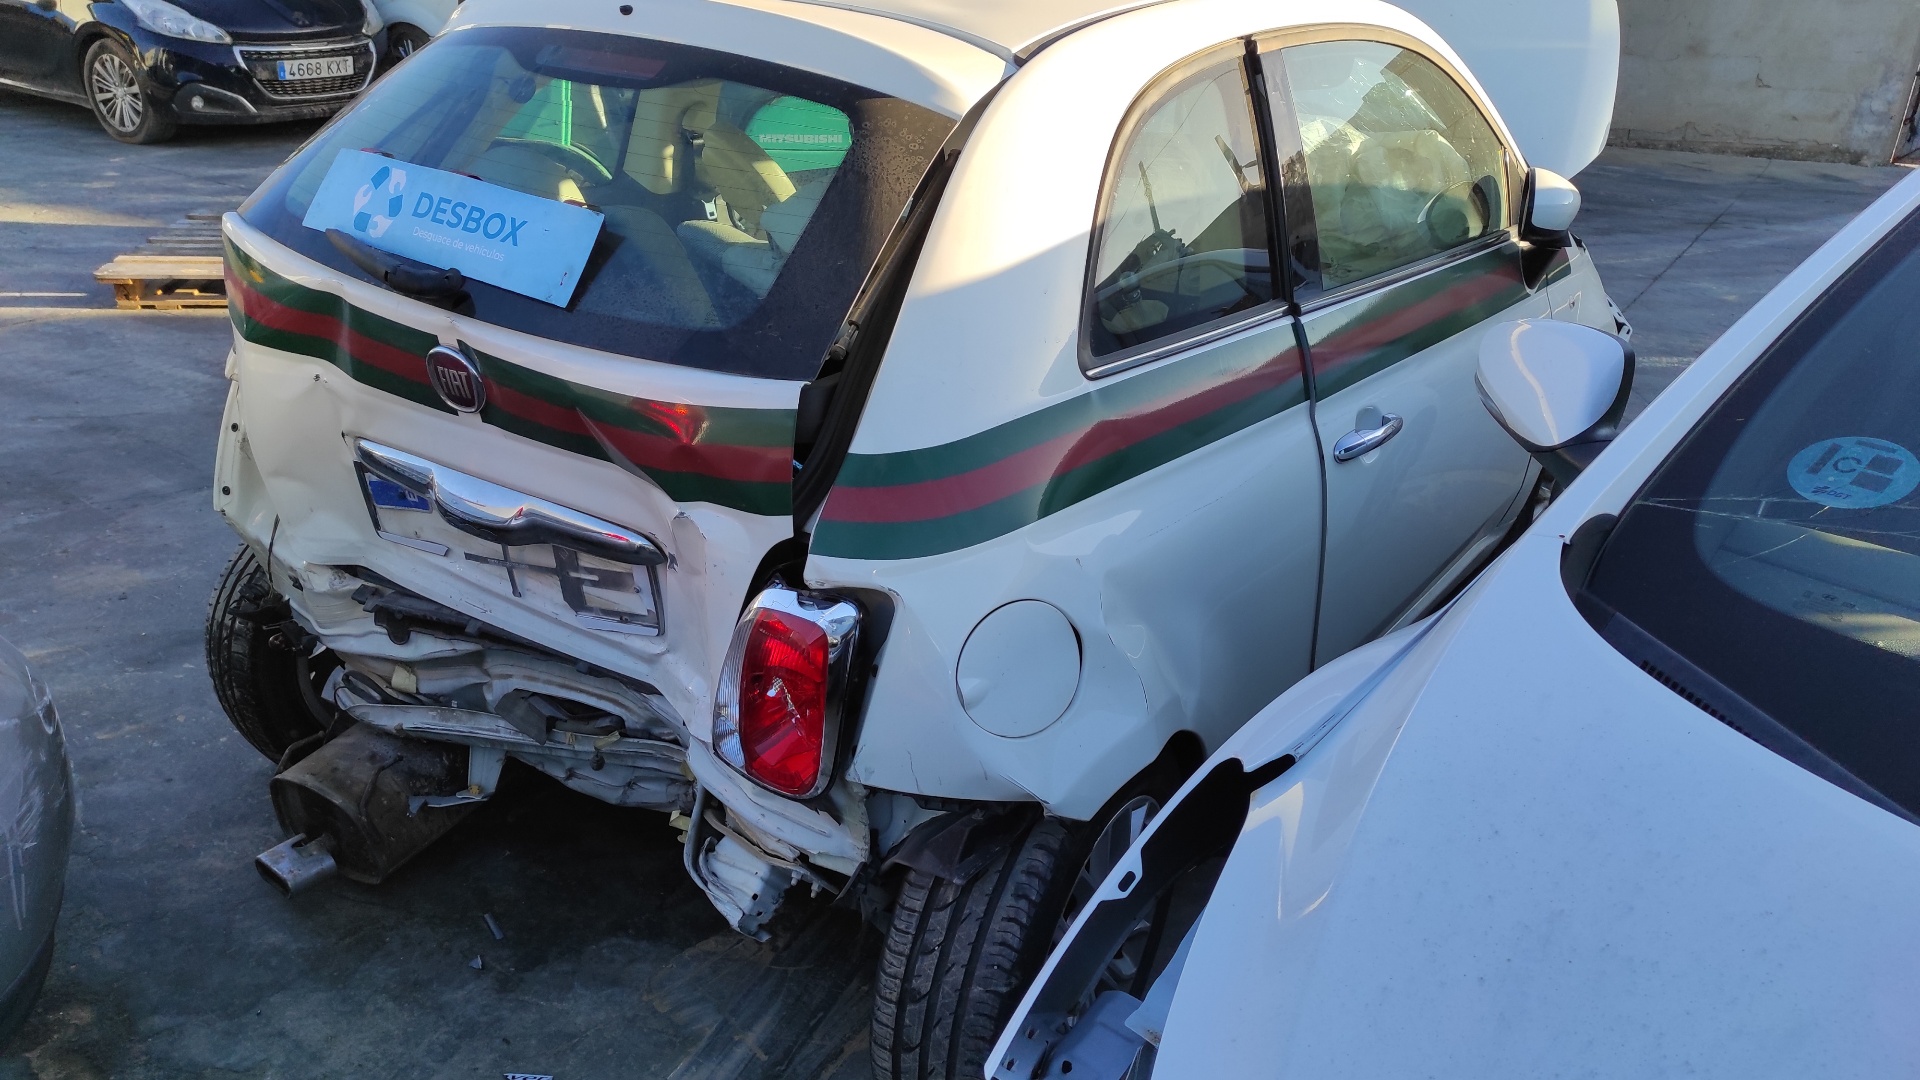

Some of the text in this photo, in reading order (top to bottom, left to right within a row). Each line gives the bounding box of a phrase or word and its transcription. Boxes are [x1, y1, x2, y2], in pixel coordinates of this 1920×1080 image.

[289, 59, 349, 77] 4668 KXT
[759, 133, 843, 144] MITSUBISHI
[411, 191, 528, 247] DESBOX
[412, 226, 505, 262] Desguace de vehículos
[437, 365, 472, 399] FIAT
[1832, 456, 1862, 473] C
